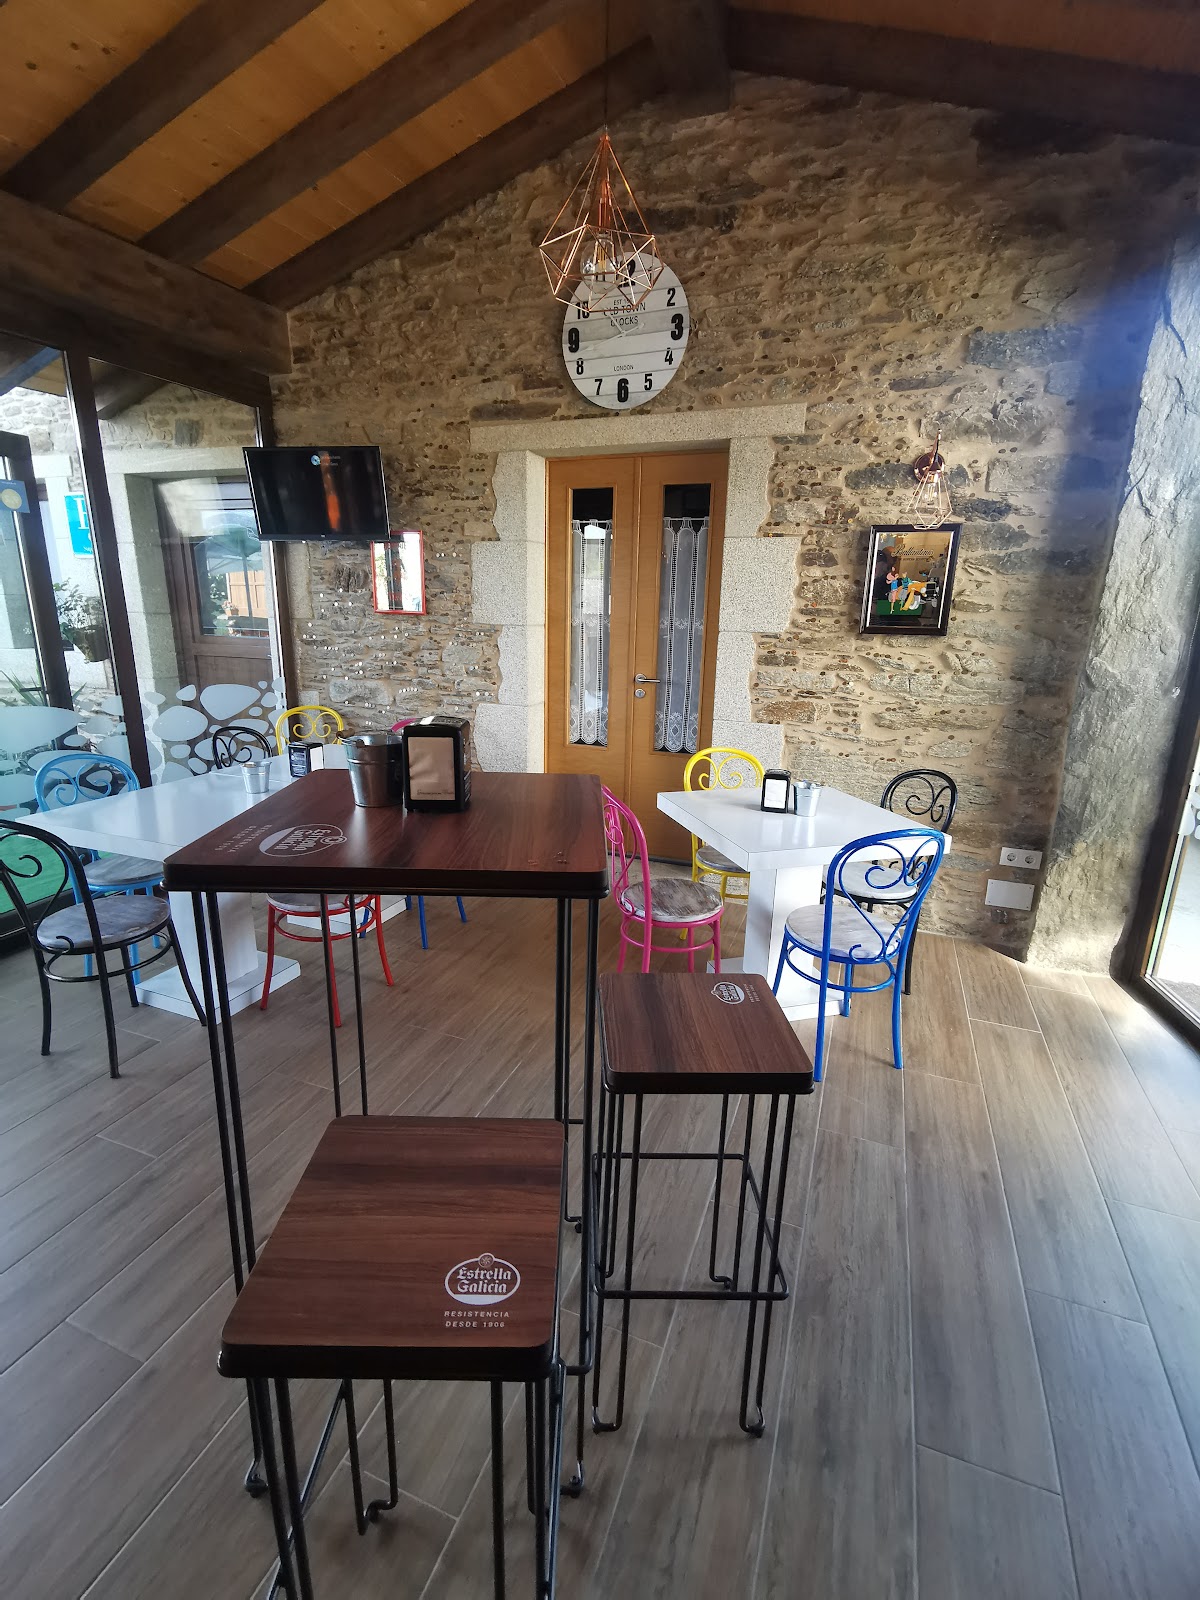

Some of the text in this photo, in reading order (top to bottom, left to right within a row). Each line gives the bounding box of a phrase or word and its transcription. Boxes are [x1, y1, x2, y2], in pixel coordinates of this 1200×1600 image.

[666, 287, 676, 307] 2
[575, 300, 590, 320] 10
[670, 313, 684, 341] 3
[567, 327, 580, 353] 9
[664, 347, 674, 366] 4
[576, 357, 584, 375] 8
[613, 364, 634, 372] LONDON
[594, 378, 603, 396] 7
[617, 377, 629, 403] 6
[644, 373, 653, 391] 5
[273, 829, 309, 850] Galicia
[456, 1266, 512, 1280] Estrella
[457, 1279, 507, 1293] Galicia
[443, 1310, 510, 1318] RESISTENCIA
